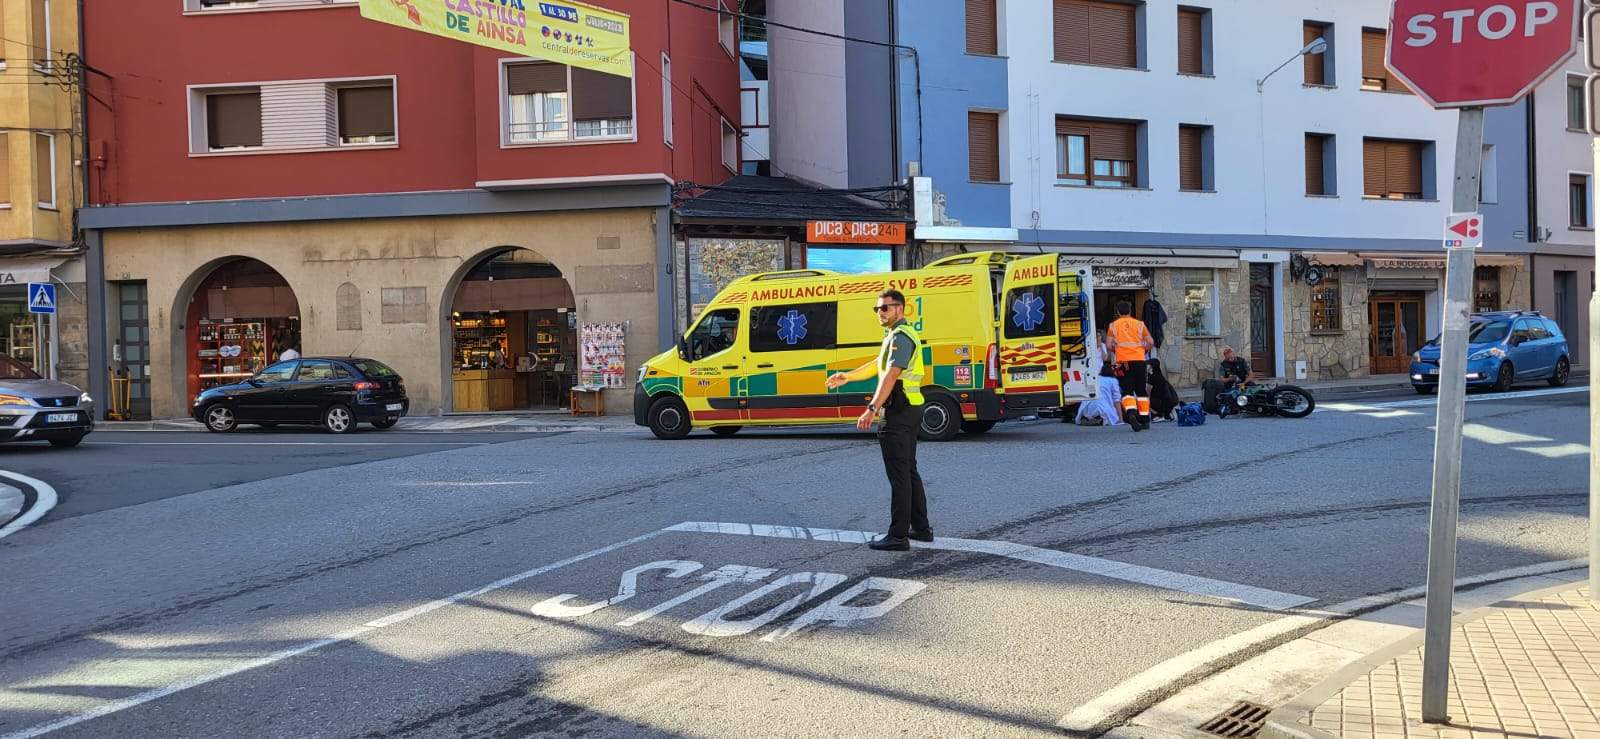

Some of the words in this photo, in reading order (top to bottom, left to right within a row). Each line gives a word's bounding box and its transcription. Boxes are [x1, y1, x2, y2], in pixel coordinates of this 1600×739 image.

[446, 11, 470, 33] DE
[477, 19, 526, 46] AINSA
[1404, 2, 1559, 47] STOP
[1013, 264, 1055, 281] AMBUL
[889, 277, 918, 290] SVB
[751, 285, 836, 301] AMBULANCIA
[955, 367, 969, 375] 112
[531, 560, 927, 642] STOP
